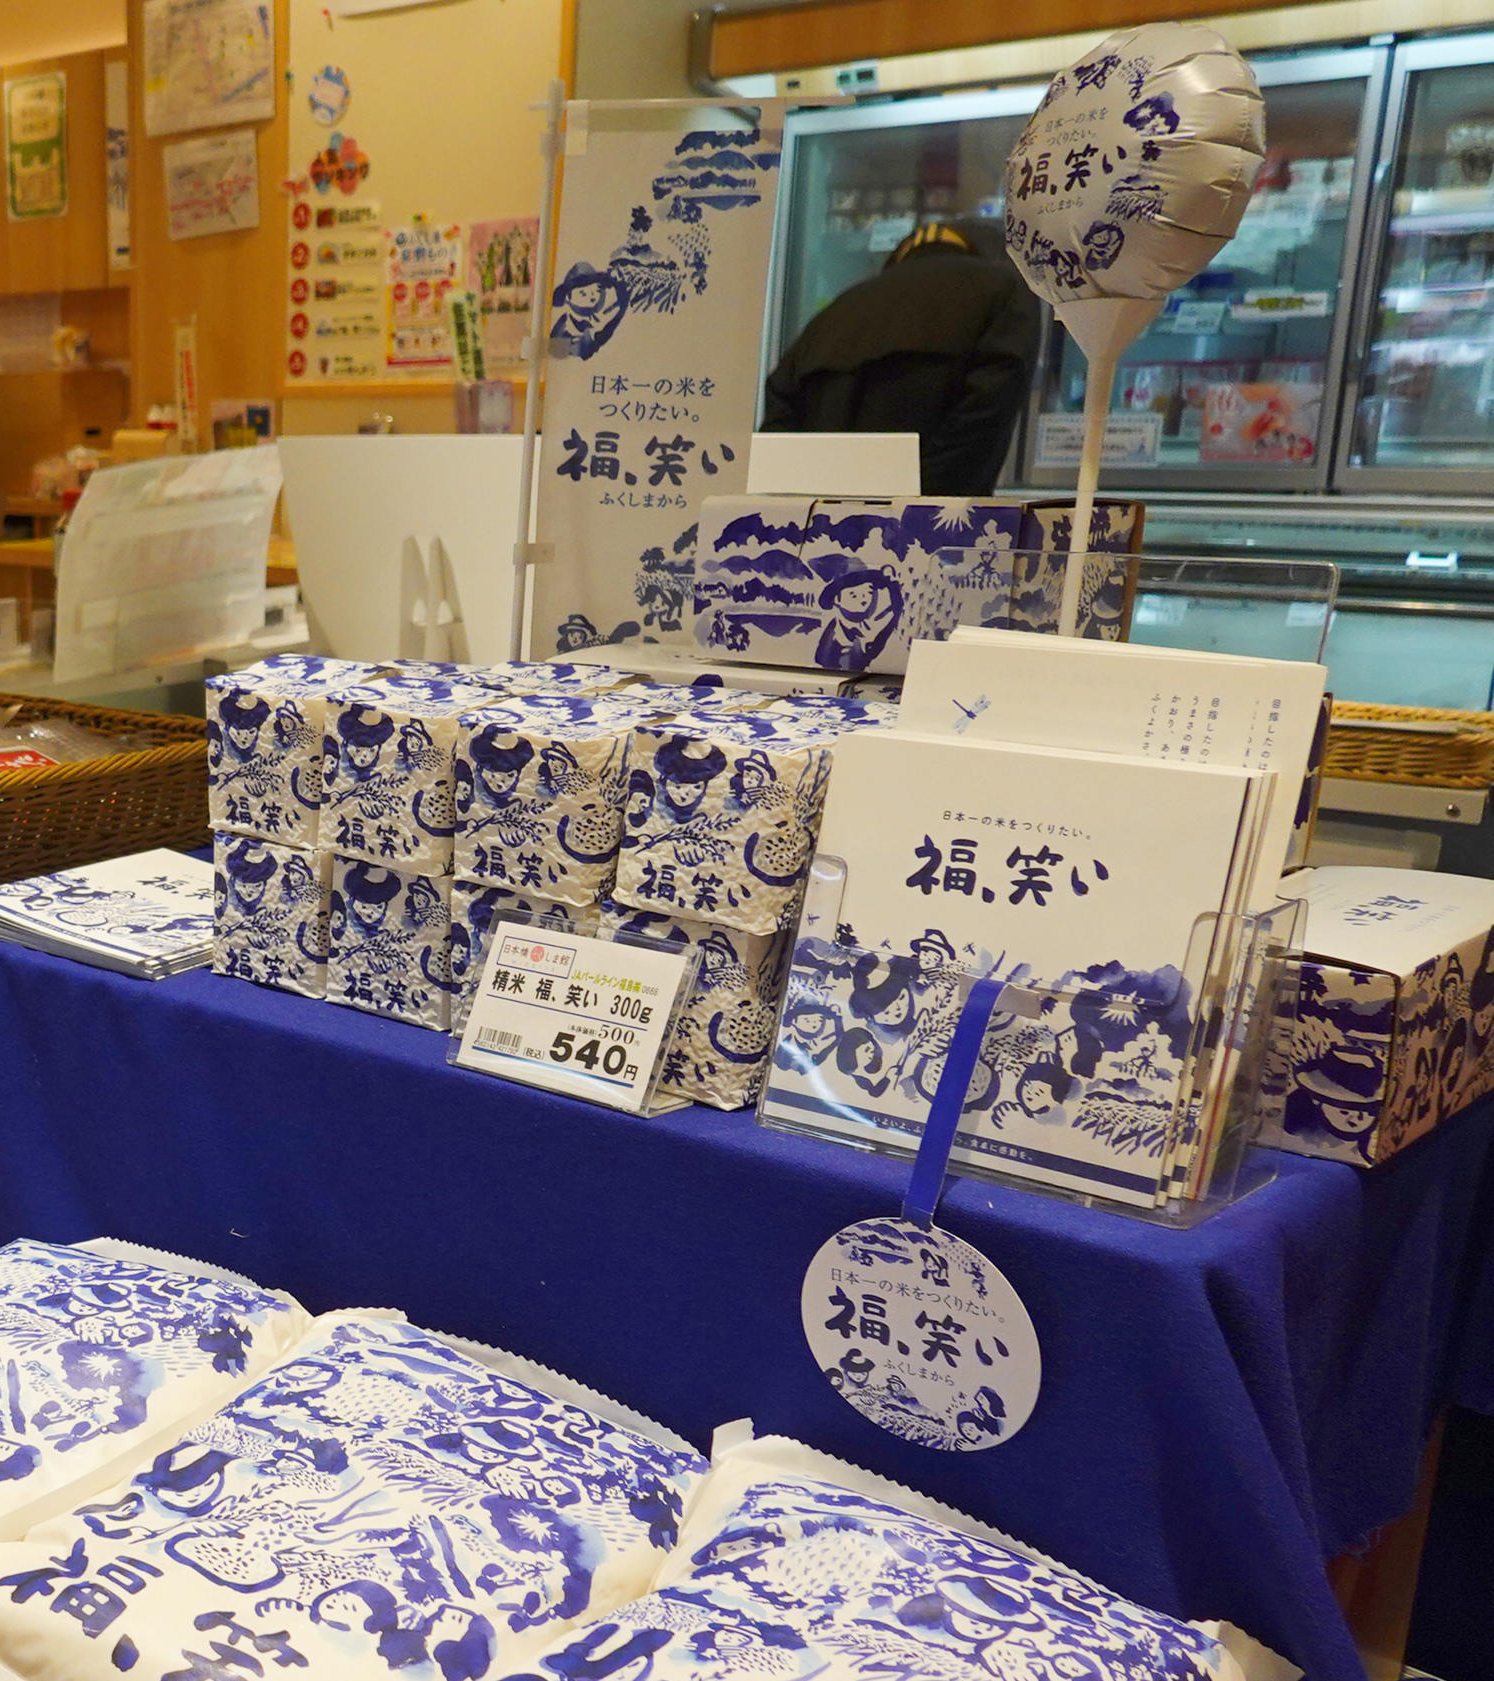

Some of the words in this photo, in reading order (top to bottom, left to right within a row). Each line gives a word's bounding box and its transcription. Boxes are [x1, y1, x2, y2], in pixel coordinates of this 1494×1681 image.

[1017, 143, 1127, 201] 福、笑い
[591, 375, 715, 398] 日本一の米を
[599, 401, 700, 423] つくりたい。
[557, 428, 735, 487] 福、笑い
[599, 492, 688, 509] ふくしまから
[226, 794, 301, 834] 福、笑い
[335, 814, 420, 859] 福、笑い
[942, 810, 1091, 841] 日本一の米をつくりたい。
[472, 842, 568, 888] 福、笑い
[637, 860, 752, 912] 福、笑い
[906, 834, 1109, 906] 福、笑い
[226, 946, 305, 985] 福、笑い
[343, 968, 429, 1012] 福、笑い
[492, 969, 525, 995] 精米
[536, 978, 598, 1009] 福、笑い
[610, 994, 654, 1025] 300g
[549, 1031, 639, 1081] 540円
[830, 1267, 1006, 1325] 日本一の米をつくりたい。
[825, 1285, 1010, 1369] 福、笑い
[883, 1358, 956, 1387] ふくしまから
